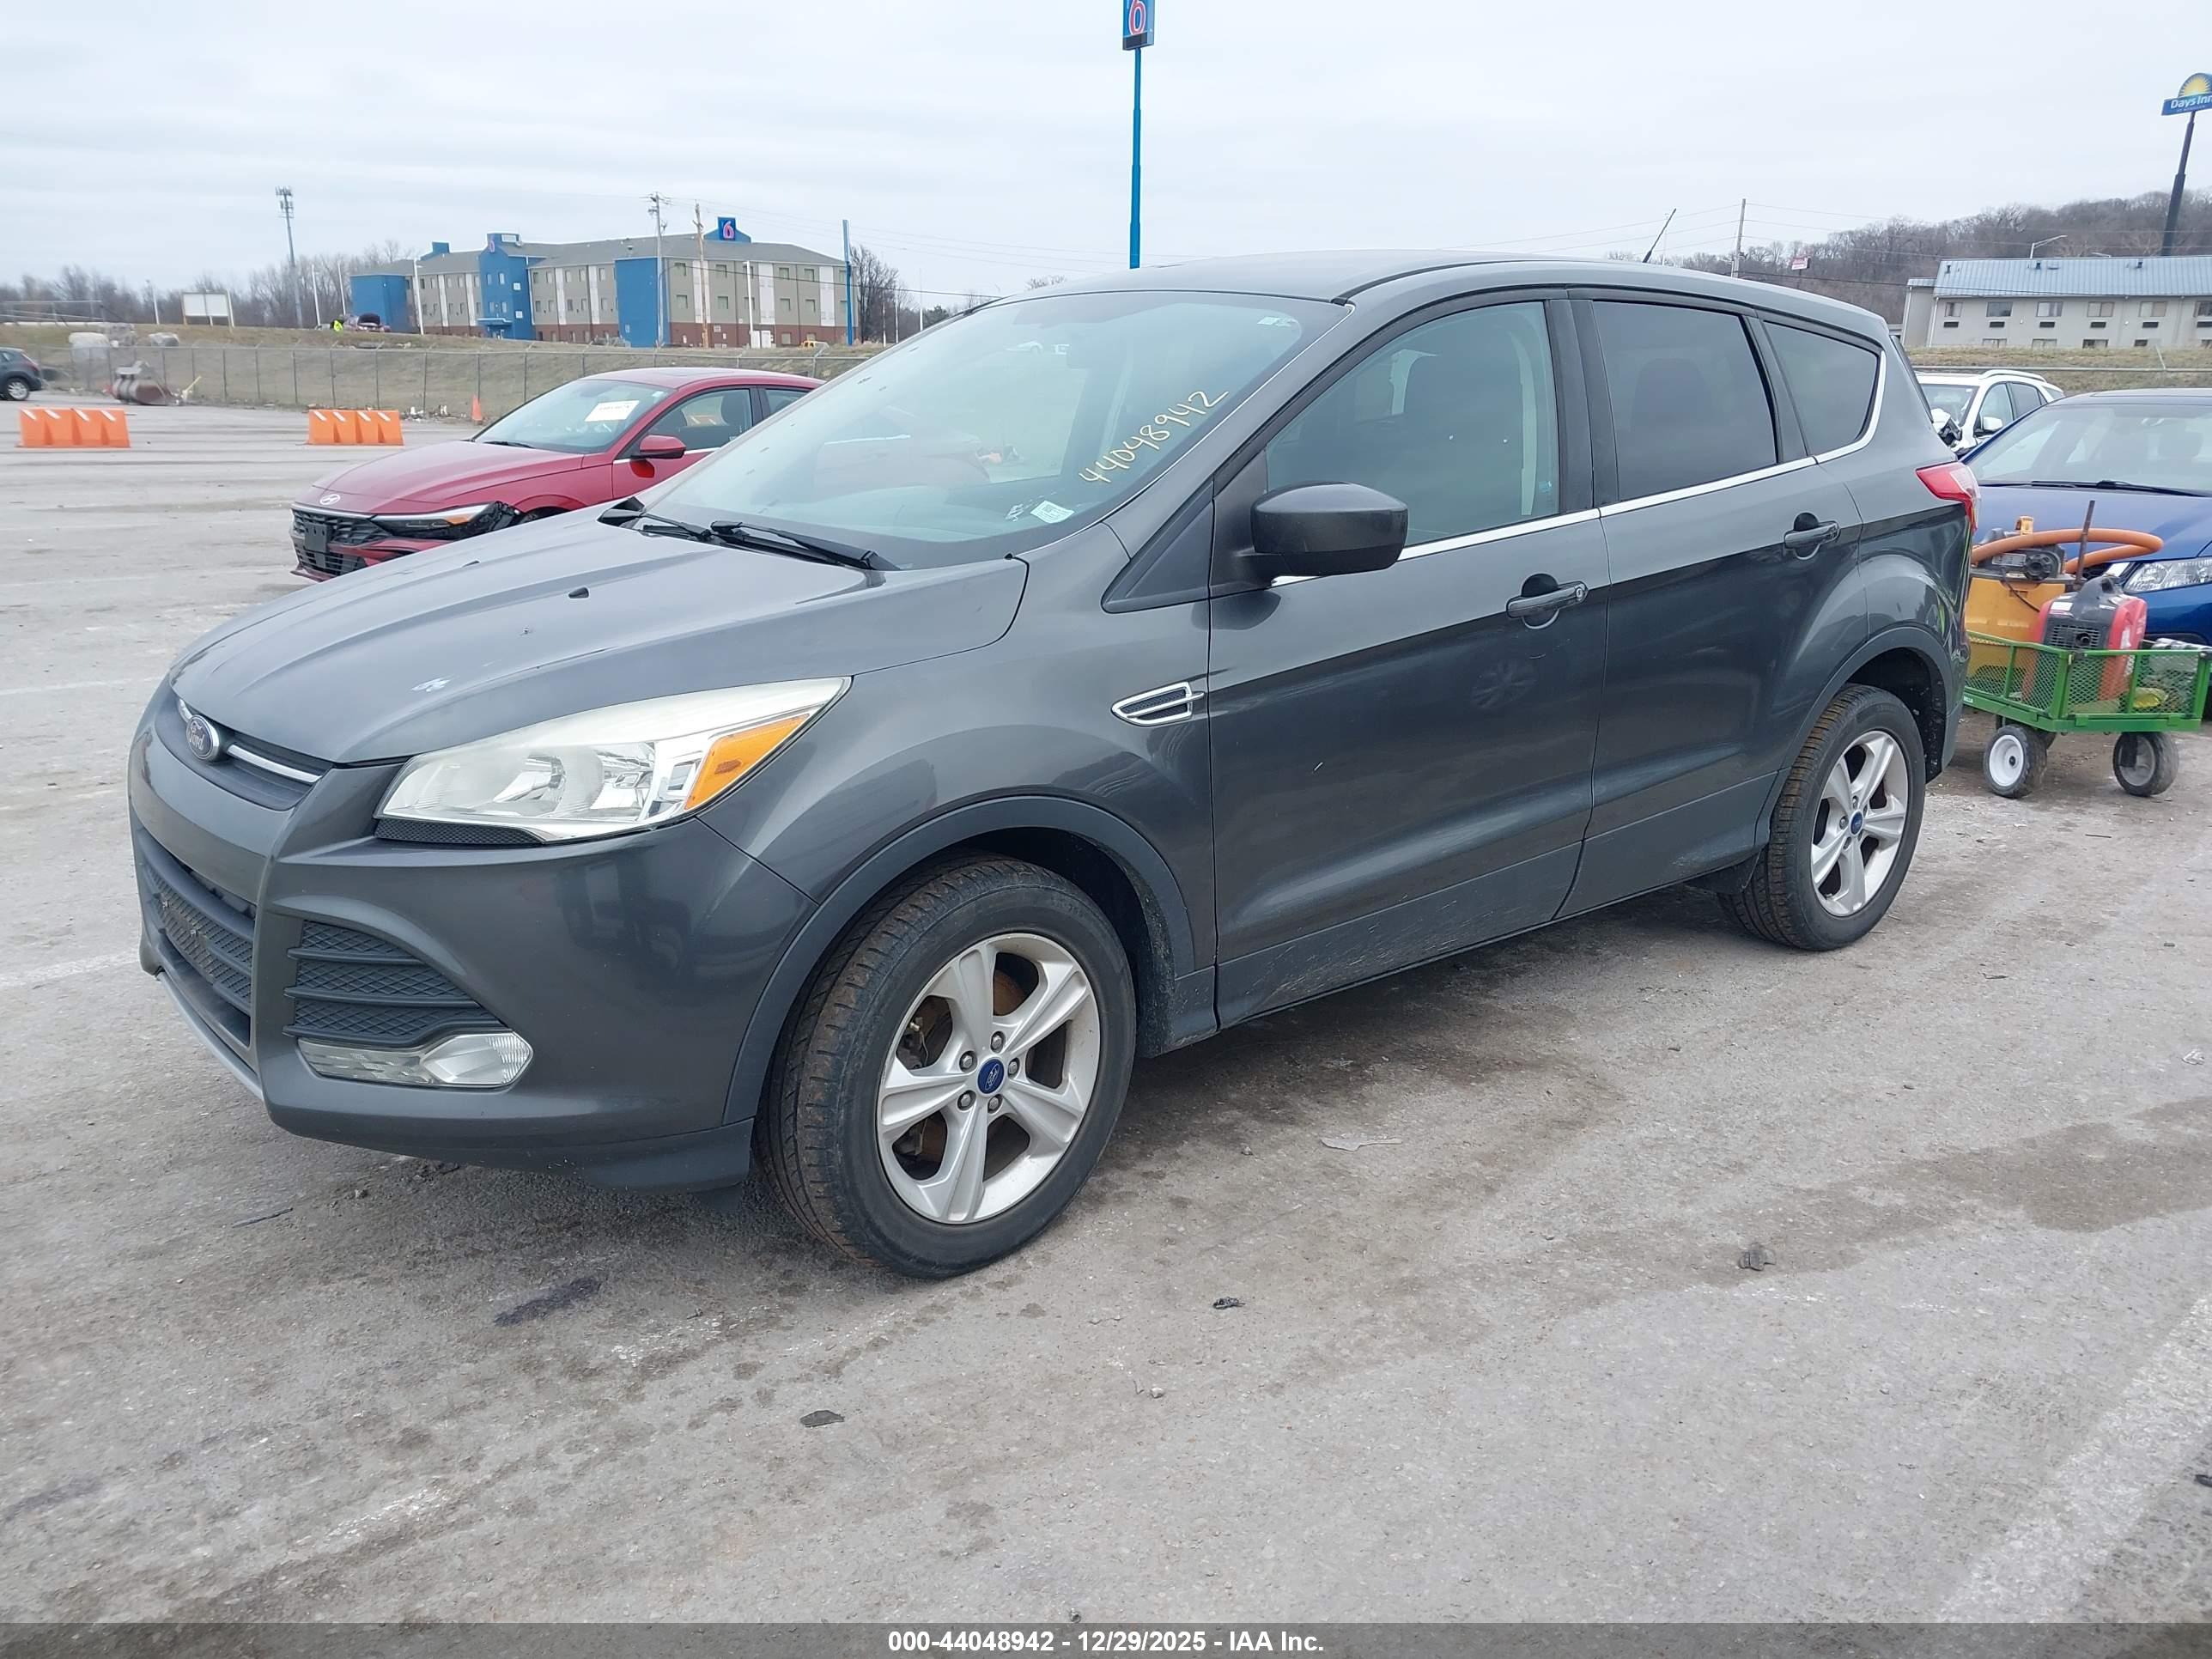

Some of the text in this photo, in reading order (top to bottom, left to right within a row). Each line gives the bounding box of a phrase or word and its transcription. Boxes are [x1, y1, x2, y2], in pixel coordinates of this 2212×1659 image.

[1128, 0, 1146, 35] 6
[2171, 98, 2197, 109] Days
[723, 221, 734, 239] 6
[1079, 391, 1230, 483] 44048942
[189, 720, 206, 751] Ford
